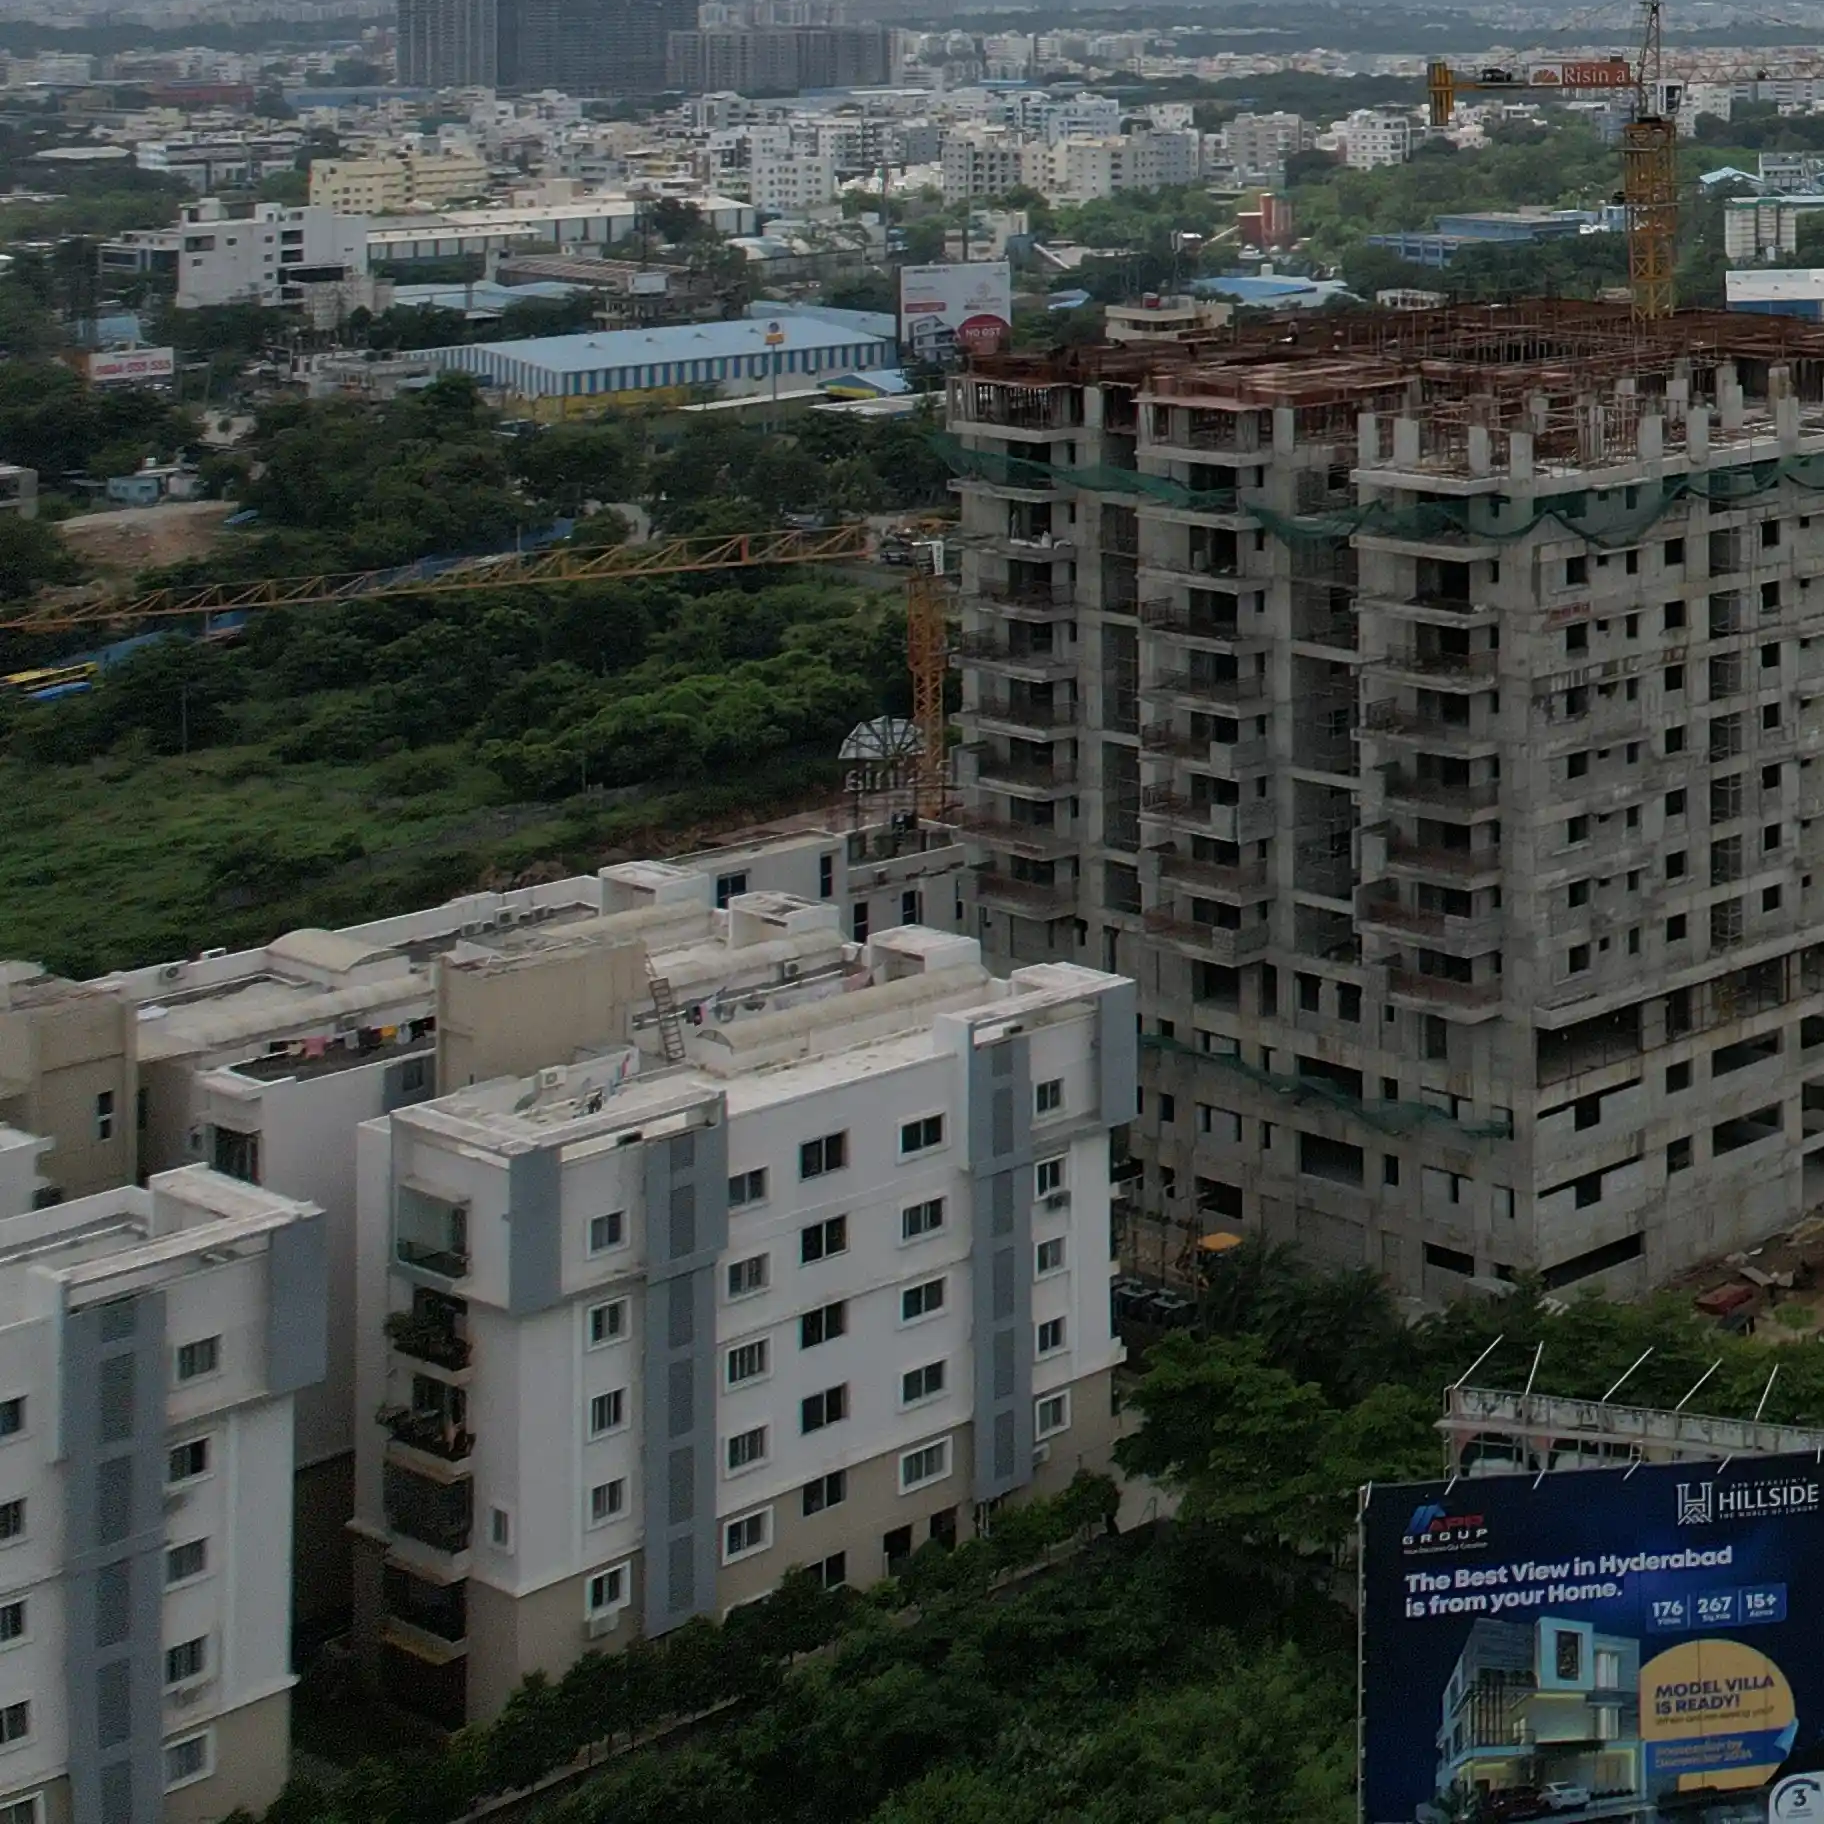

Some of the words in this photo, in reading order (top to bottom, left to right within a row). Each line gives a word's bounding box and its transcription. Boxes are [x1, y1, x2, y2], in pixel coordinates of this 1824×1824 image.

[966, 328, 980, 339] NO
[982, 327, 1001, 338] GST
[1719, 1484, 1819, 1511] HILLSIDE
[1402, 1528, 1488, 1545] GROUP
[1405, 1572, 1451, 1593] The
[1455, 1563, 1508, 1589] Best
[1511, 1560, 1569, 1582] View
[1574, 1556, 1595, 1577] in
[1600, 1545, 1733, 1578] Hyderabad
[1405, 1597, 1425, 1618] is
[1428, 1592, 1487, 1615] from
[1491, 1586, 1546, 1614] your
[1549, 1581, 1623, 1604] Home.
[1652, 1600, 1684, 1618] 176
[1697, 1596, 1732, 1614] 267
[1746, 1593, 1777, 1610] 15+
[1656, 1679, 1722, 1699] MODEL
[1725, 1675, 1775, 1692] VILLA
[1656, 1700, 1672, 1715] IS
[1675, 1693, 1740, 1714] READY!
[1793, 1788, 1807, 1807] 3
